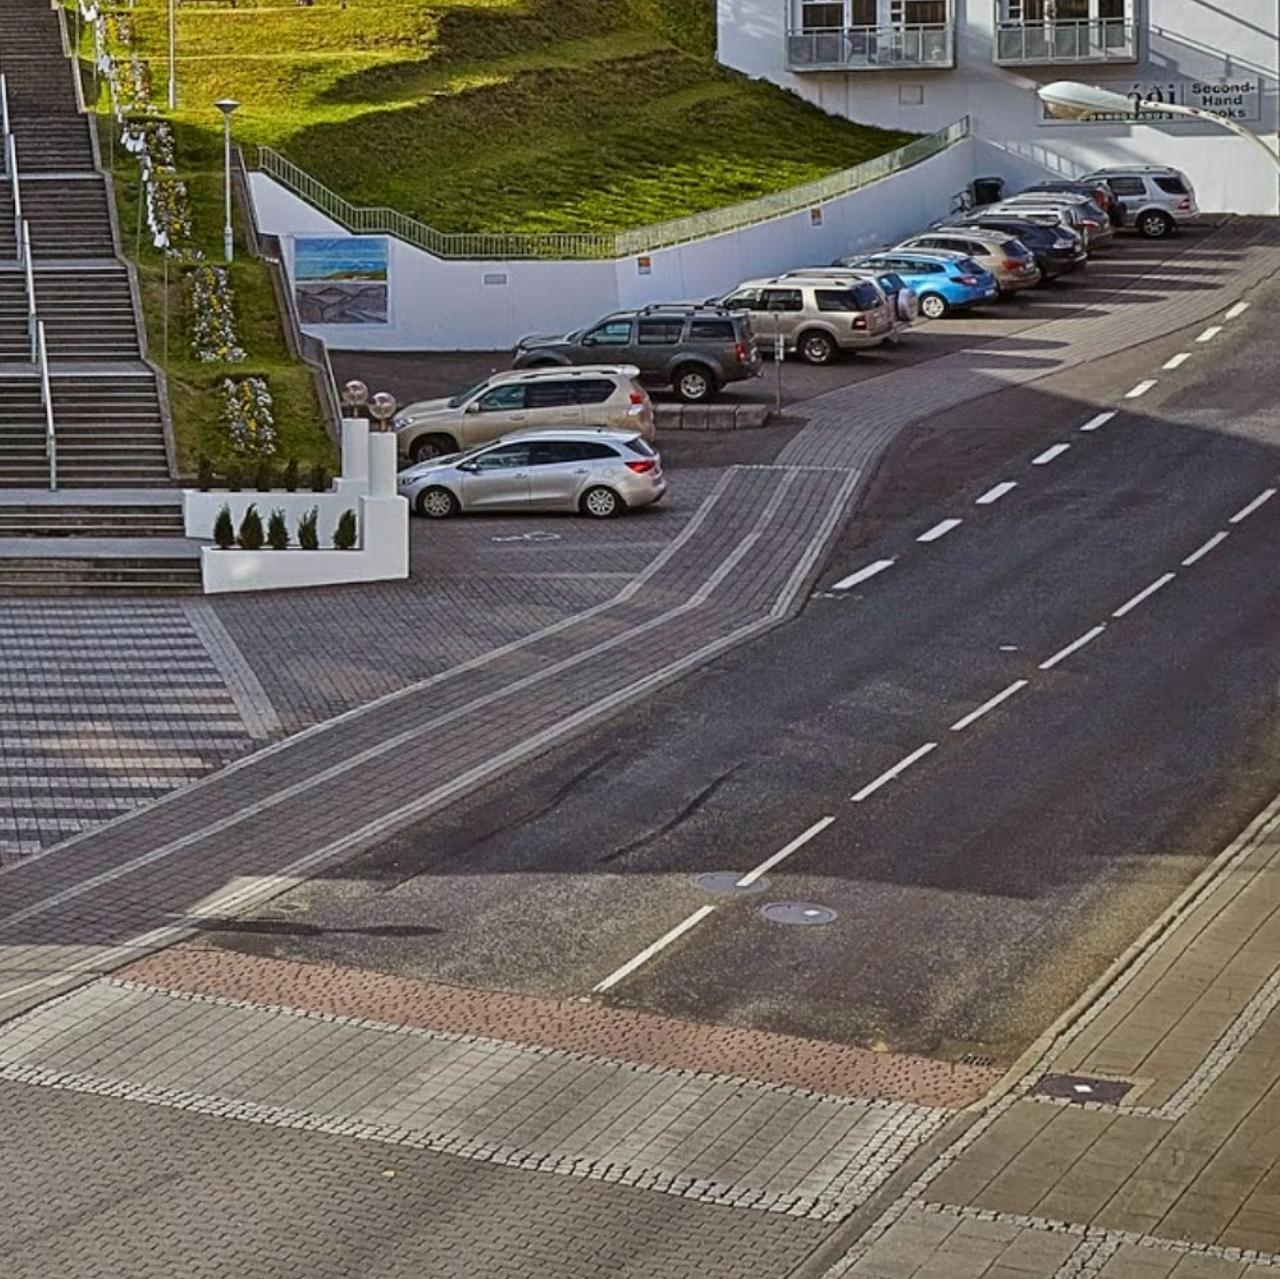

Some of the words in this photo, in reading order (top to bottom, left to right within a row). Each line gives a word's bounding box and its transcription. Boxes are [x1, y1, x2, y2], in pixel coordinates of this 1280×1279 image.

[1192, 82, 1255, 94] Second-
[1202, 94, 1243, 106] Hand
[1201, 107, 1247, 118] oks
